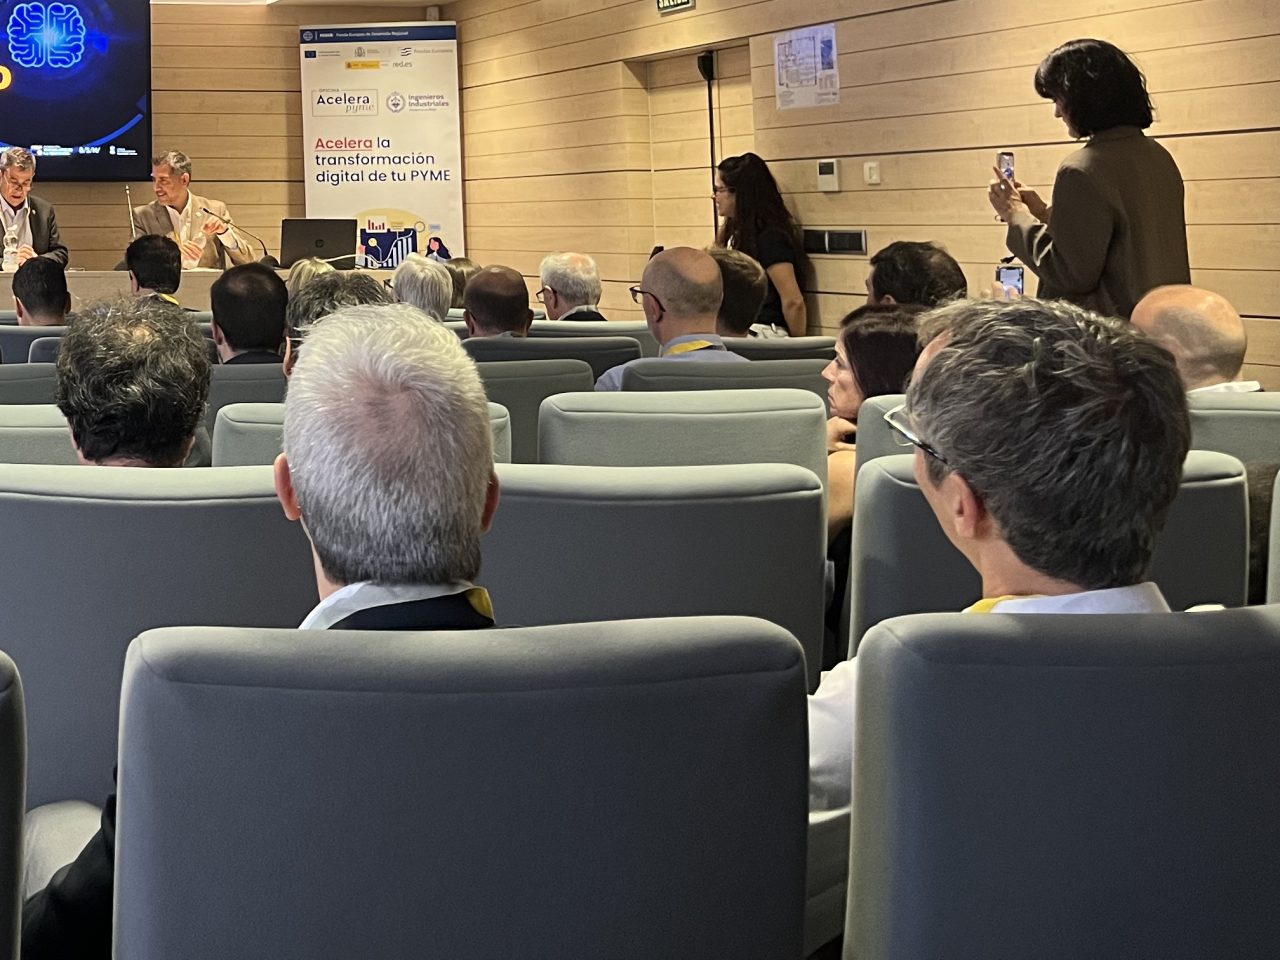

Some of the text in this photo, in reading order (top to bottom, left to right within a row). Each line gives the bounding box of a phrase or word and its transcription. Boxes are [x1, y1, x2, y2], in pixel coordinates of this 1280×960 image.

[316, 93, 370, 105] Acelera
[408, 94, 445, 103] Ingenieros
[345, 104, 375, 113] pyme
[315, 137, 391, 150] Acelera la
[315, 152, 435, 166] transformación
[315, 169, 451, 186] digital de tu PYME
